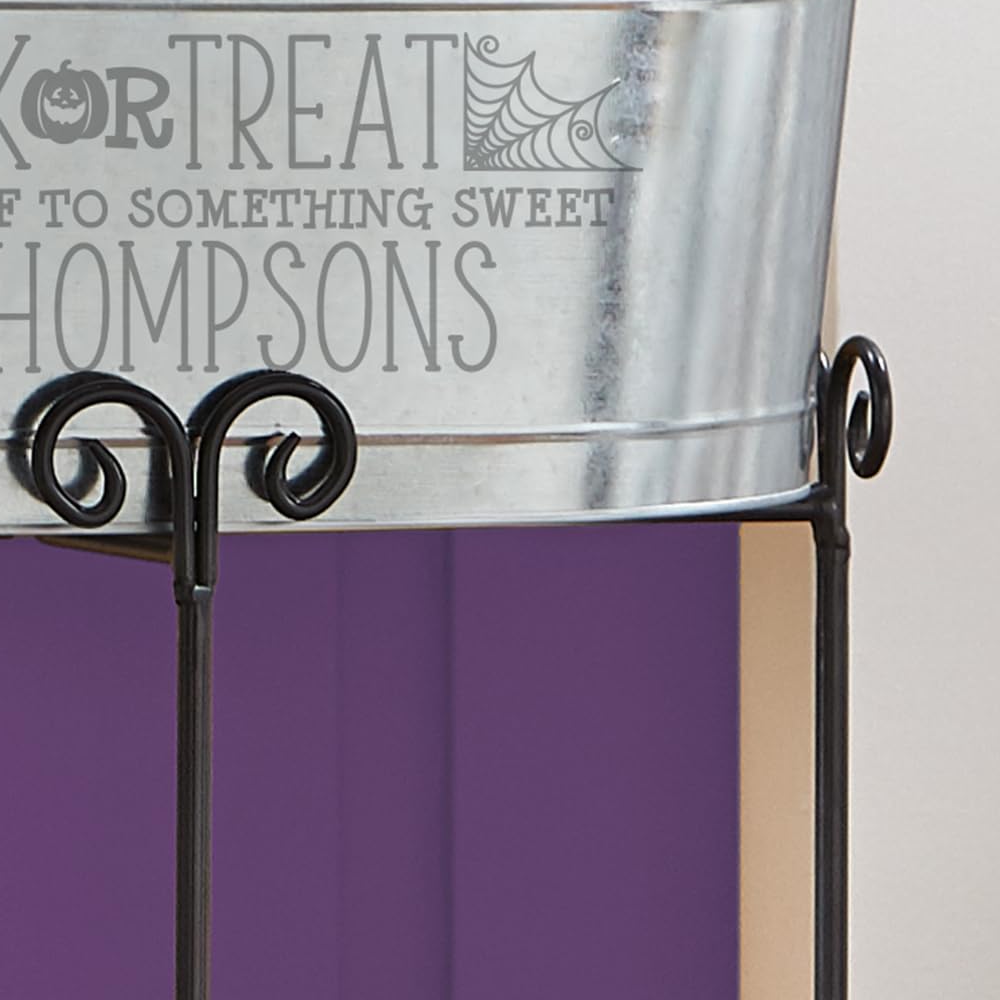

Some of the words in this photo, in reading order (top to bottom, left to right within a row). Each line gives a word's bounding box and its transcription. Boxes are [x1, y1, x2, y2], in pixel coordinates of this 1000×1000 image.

[20, 60, 174, 149] OR
[168, 34, 459, 170] TREAT
[39, 189, 108, 228] TO
[128, 187, 434, 229] SOMETHING
[452, 187, 615, 228] SWEET
